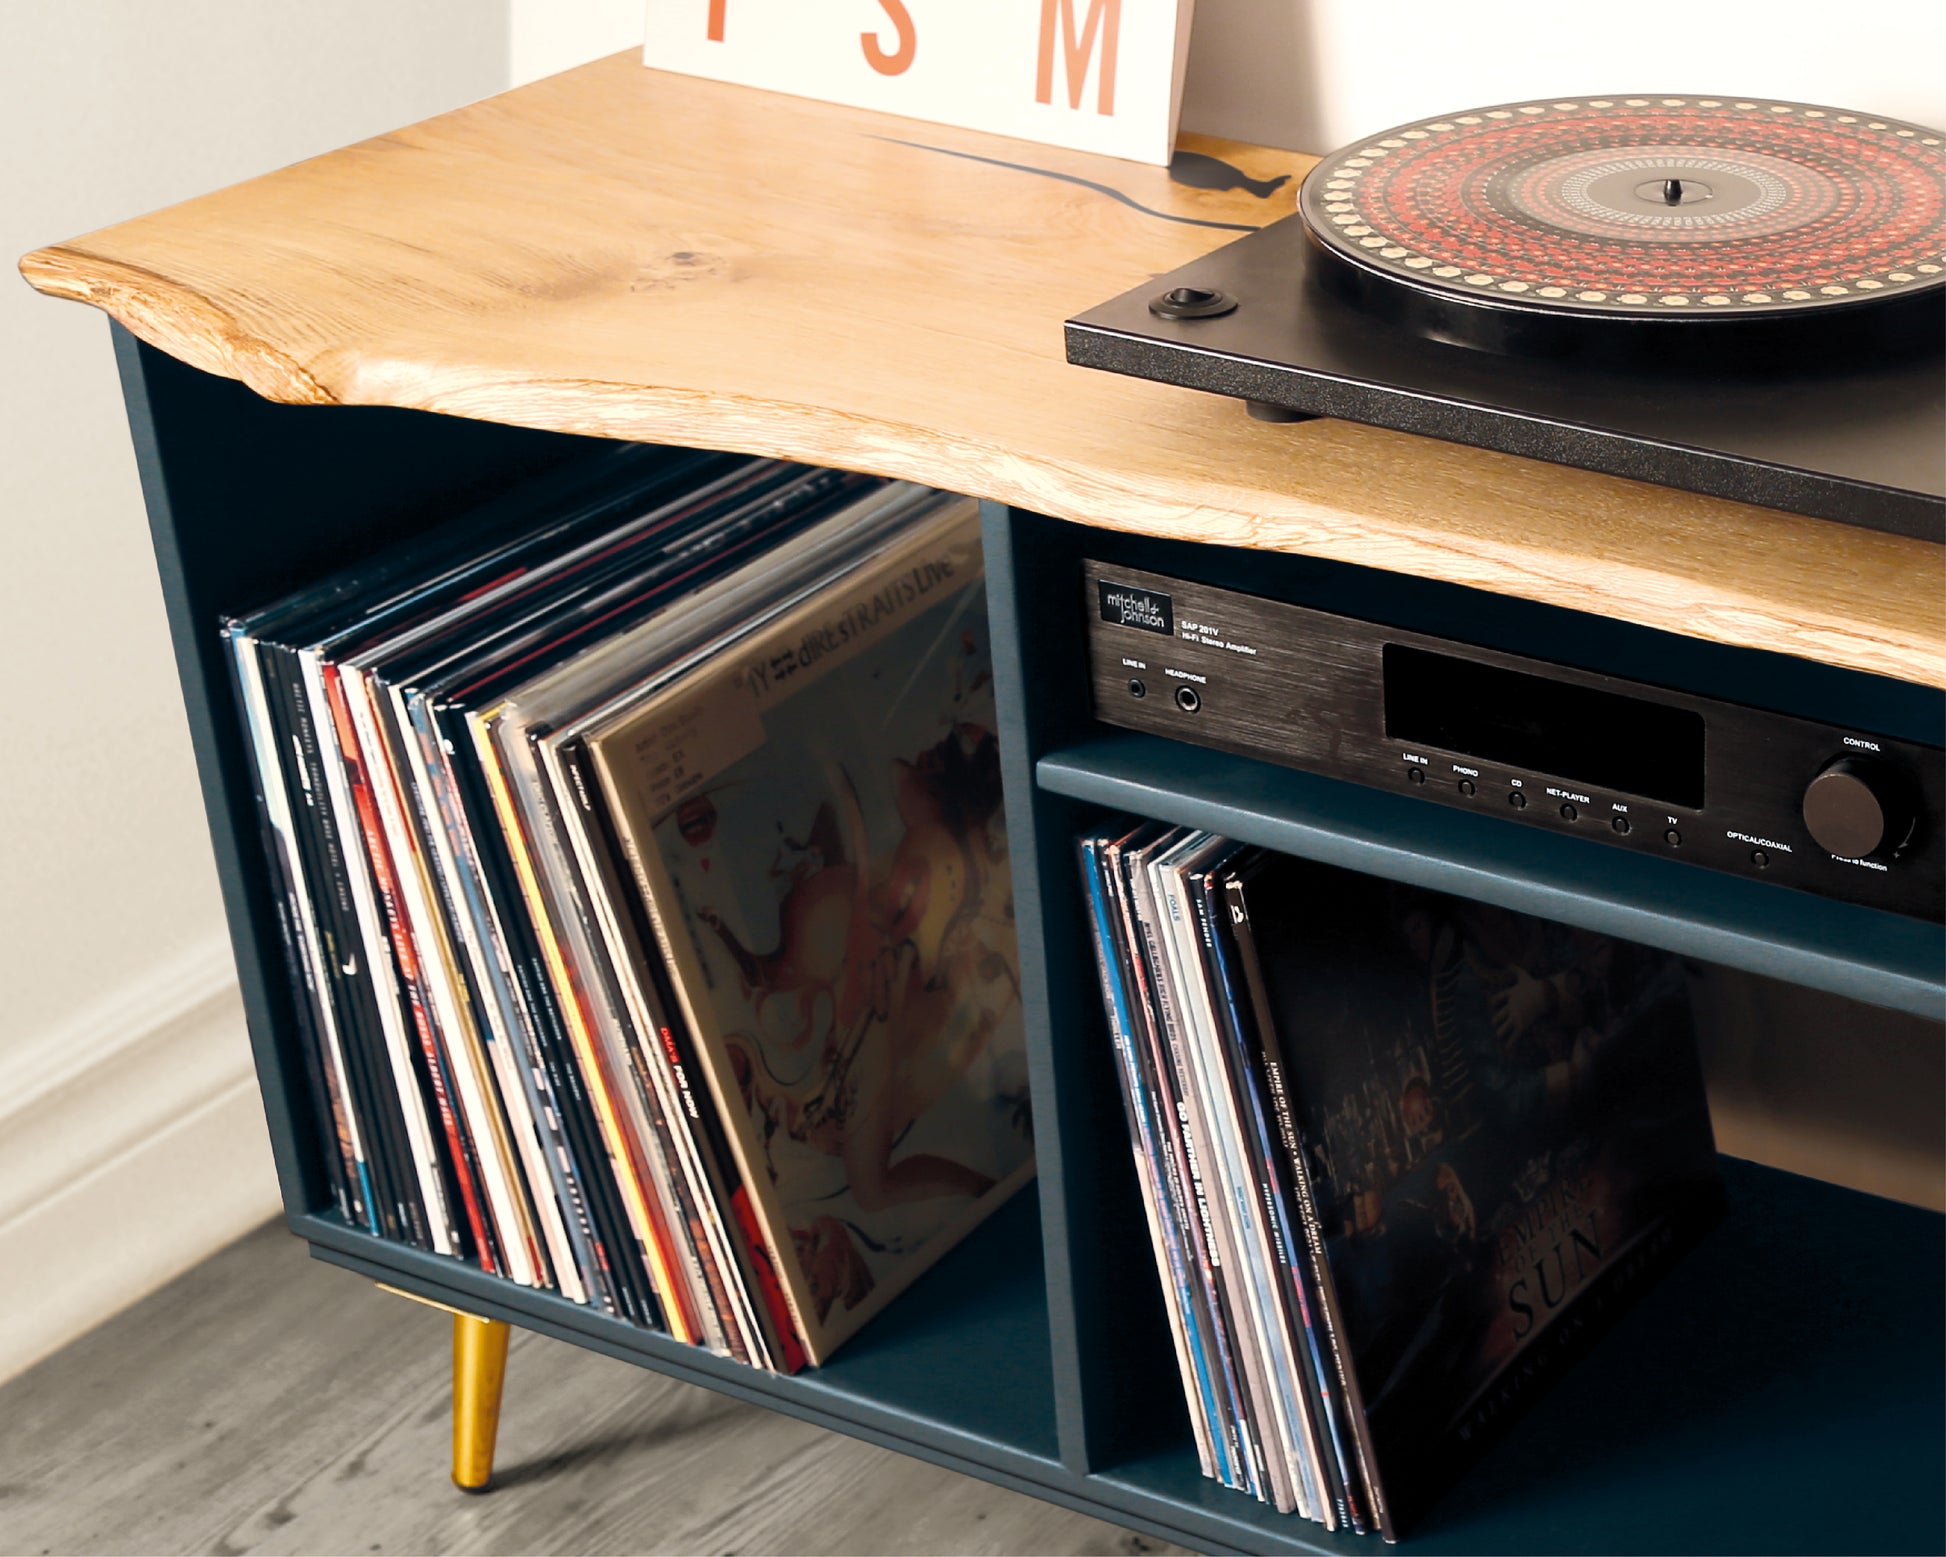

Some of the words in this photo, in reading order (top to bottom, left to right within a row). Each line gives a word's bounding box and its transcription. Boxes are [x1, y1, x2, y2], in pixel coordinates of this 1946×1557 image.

[1107, 594, 1149, 612] mitchell
[1121, 608, 1164, 628] johnson
[1181, 620, 1198, 631] SAP
[1199, 624, 1219, 636] 201V
[1182, 632, 1200, 642] Hi-Fi
[1201, 636, 1224, 648] Stereo
[1226, 641, 1257, 655] Amplifier
[1122, 658, 1138, 668] LINE
[1138, 661, 1146, 669] IN
[1165, 668, 1207, 684] HEADPHONE
[298, 716, 314, 754] MONKEYS
[1843, 736, 1881, 752] CONTROL
[1403, 753, 1420, 763] LINE
[1420, 757, 1428, 765] IN
[1453, 765, 1479, 777] PHONO
[1511, 779, 1522, 788] CD
[1546, 787, 1590, 804] NET-PLAYER
[1612, 803, 1628, 813] AUX
[1667, 816, 1678, 825] TV
[1726, 831, 1793, 853] OPTICAL/COAXIAL
[1859, 859, 1888, 872] function
[1167, 893, 1181, 921] FOALS
[364, 828, 386, 874] ARCTIC
[377, 875, 402, 931] MONKEYS
[392, 931, 412, 964] LIVE
[425, 1051, 446, 1094] ALBERT
[1195, 897, 1205, 916] SAM
[1200, 917, 1213, 948] FENDER
[1261, 1182, 1278, 1230] HYPERSONIC
[1273, 1230, 1286, 1264] MISSILES
[1269, 1060, 1284, 1096] EMPIRE
[671, 1062, 689, 1091] FOR
[681, 1088, 699, 1121] NOW
[1174, 1100, 1189, 1122] GO
[1281, 1110, 1293, 1131] THE
[1286, 1129, 1297, 1150] SUN
[1180, 1122, 1201, 1181] FARTHER
[1192, 1179, 1205, 1196] IN
[1292, 1156, 1309, 1198] WALKING
[1195, 1195, 1221, 1268] LIGHTNESS
[1308, 1222, 1322, 1255] DREAM
[1508, 1209, 1604, 1342] SUN
